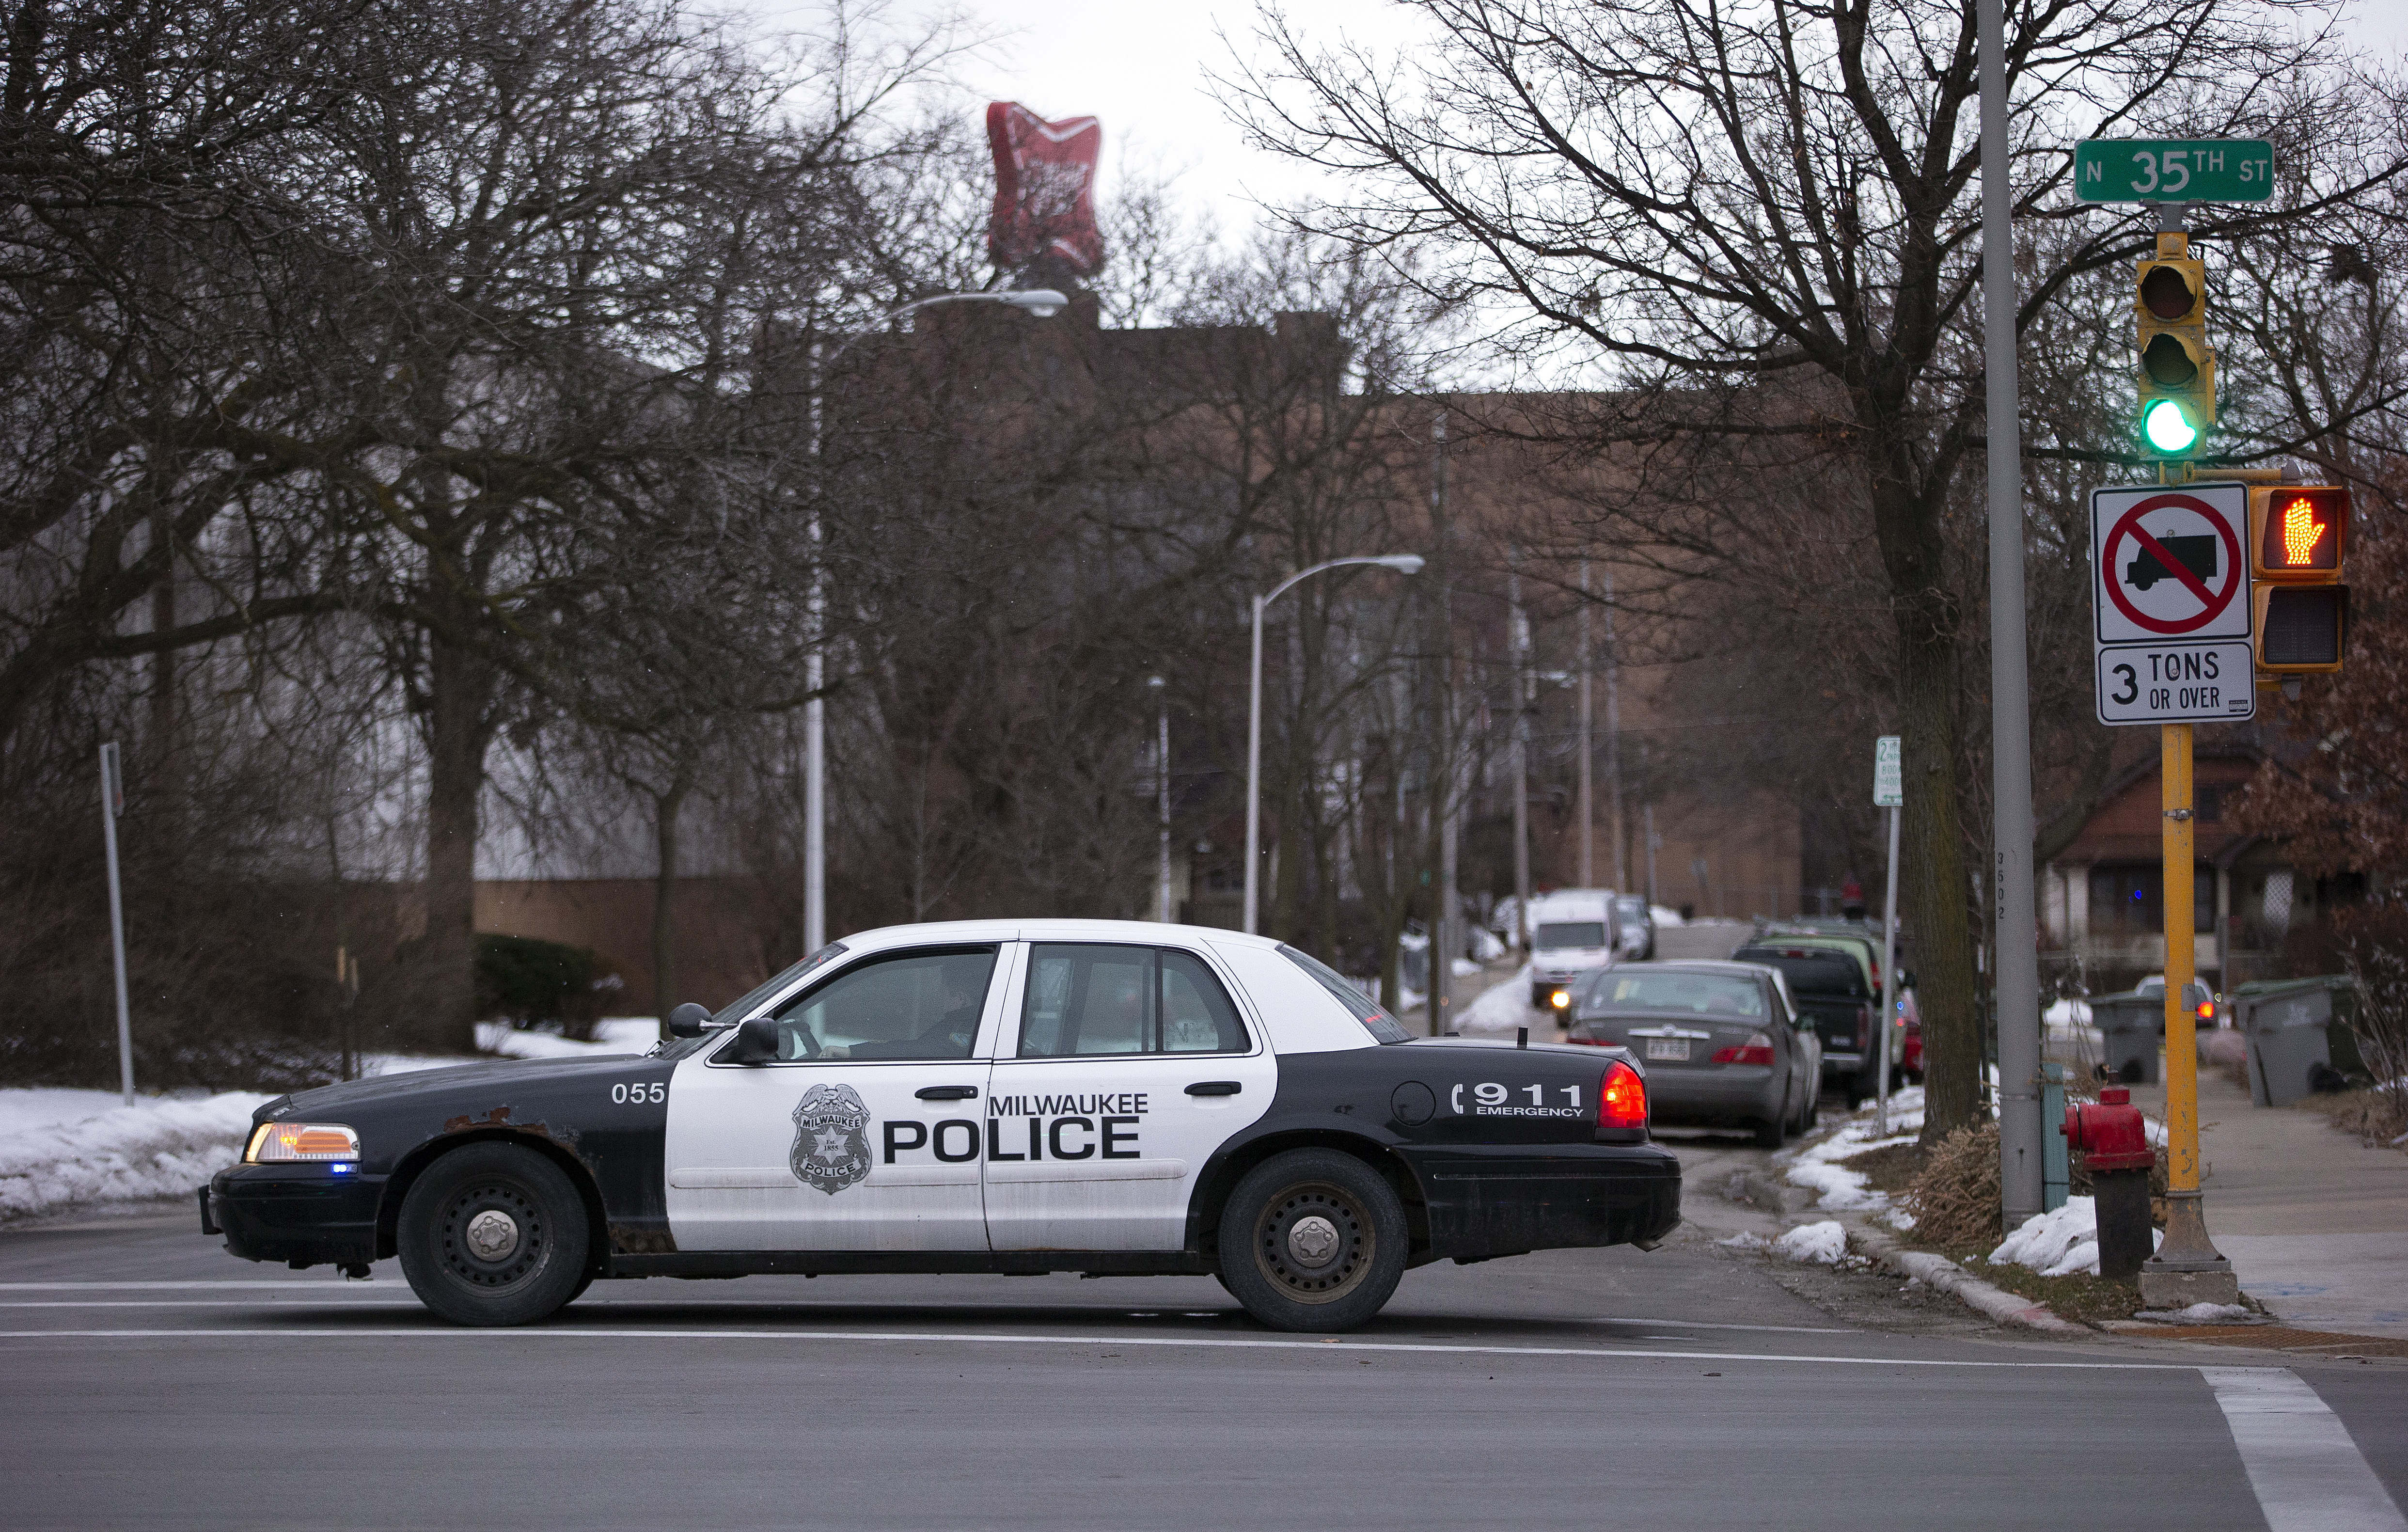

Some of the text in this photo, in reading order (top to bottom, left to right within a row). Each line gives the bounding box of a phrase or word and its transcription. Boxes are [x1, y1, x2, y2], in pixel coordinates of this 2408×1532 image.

[2086, 150, 2268, 193] N 35TH ST
[2147, 651, 2219, 681] TONS
[2111, 663, 2139, 705] 3
[2150, 688, 2170, 710] OR
[2179, 687, 2220, 709] OVER
[612, 1082, 665, 1104] 055
[990, 1093, 1149, 1116] MILWAUKEE
[1474, 1082, 1580, 1107] 911
[803, 1115, 860, 1128] MILWAUKEE
[1477, 1106, 1584, 1117] EMERGENCY
[883, 1116, 1141, 1164] POLICE
[804, 1163, 856, 1176] POLICE
